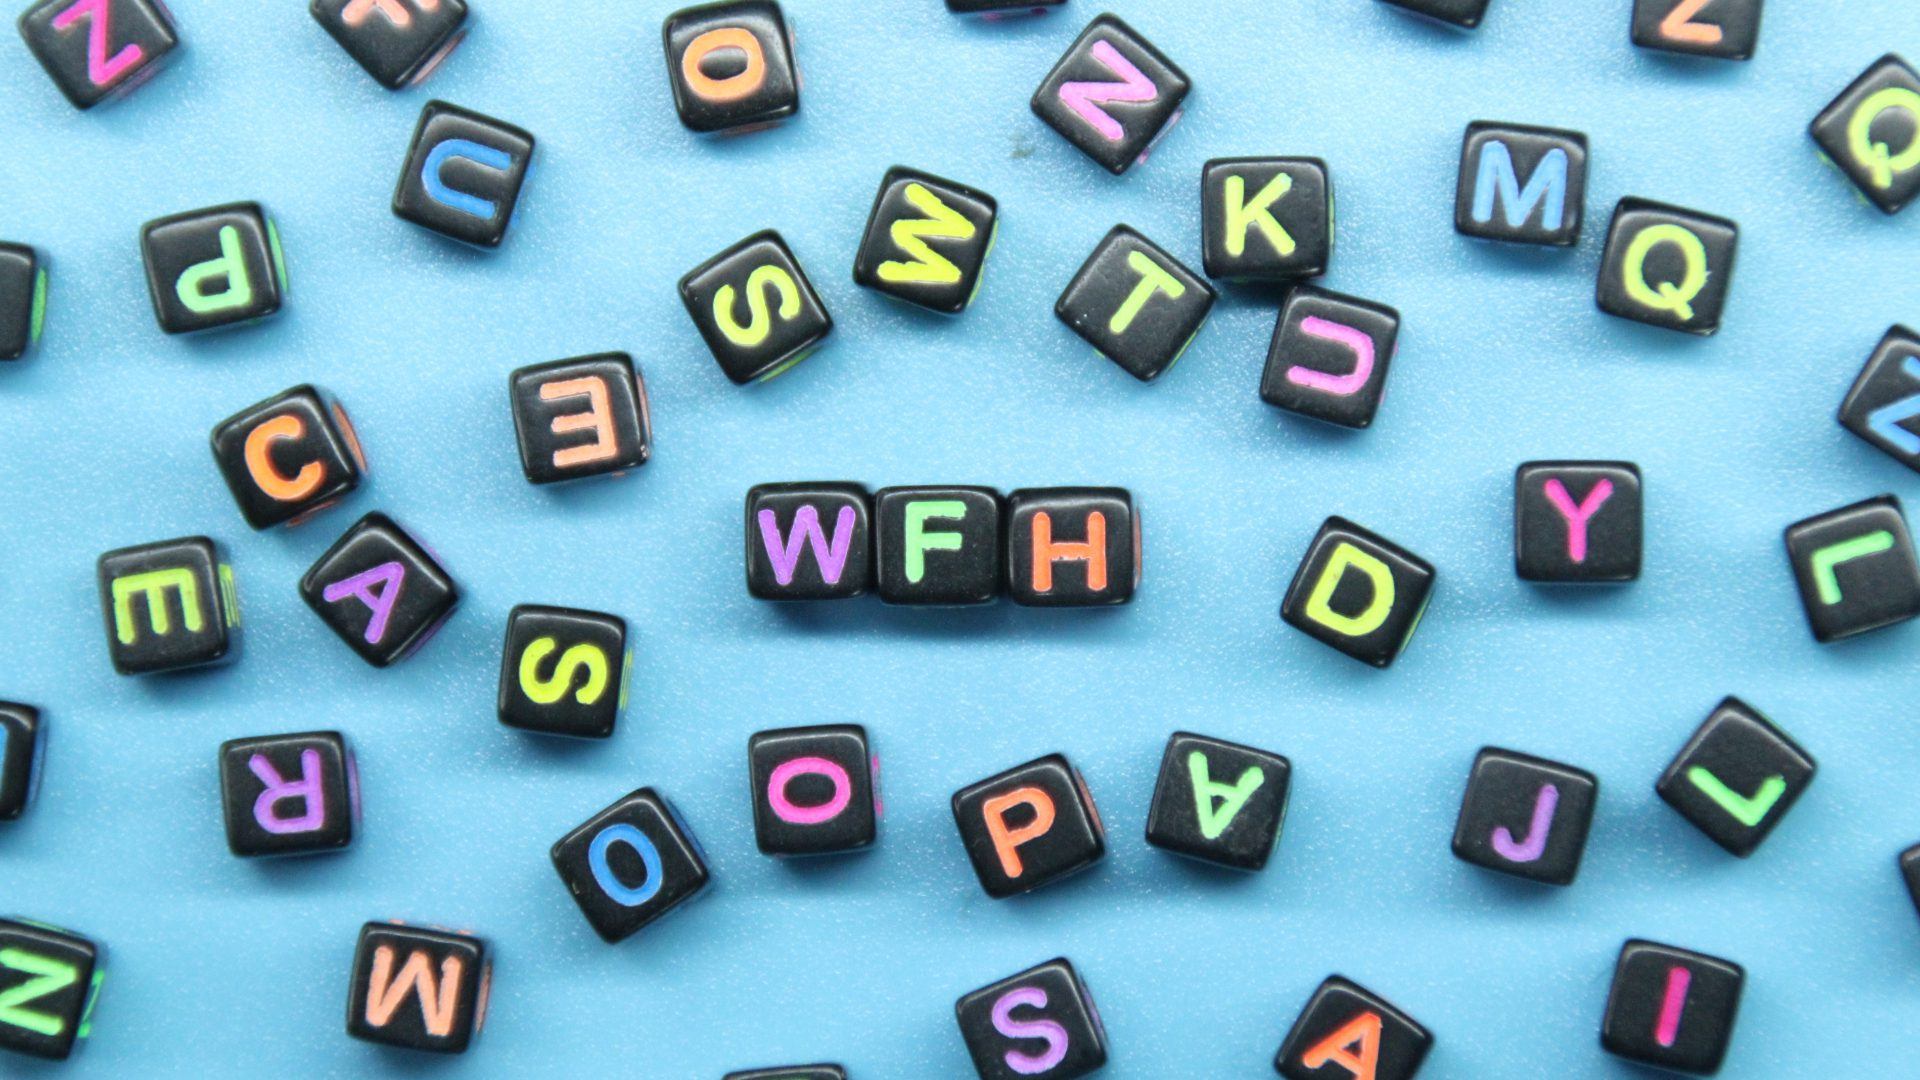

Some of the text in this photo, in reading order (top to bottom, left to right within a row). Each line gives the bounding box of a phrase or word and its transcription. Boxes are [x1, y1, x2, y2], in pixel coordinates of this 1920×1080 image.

[52, 0, 143, 86] Z
[681, 26, 766, 104] O
[1058, 39, 1158, 141] N
[420, 137, 514, 220] U
[1847, 86, 1920, 190] Q
[1224, 173, 1297, 257] K
[1470, 139, 1571, 232] M
[175, 224, 252, 314] P
[876, 181, 977, 285] W
[1622, 223, 1712, 321] Q
[712, 264, 804, 346] S
[1110, 251, 1186, 334] T
[1286, 315, 1378, 395] U
[243, 413, 328, 503] C
[540, 376, 619, 468] E
[757, 500, 1109, 594] WFH
[1543, 477, 1615, 565] Y
[111, 567, 204, 645] E
[322, 560, 406, 645] A
[1303, 543, 1397, 637] D
[1810, 529, 1896, 606] L
[518, 635, 609, 706] S
[247, 748, 326, 835] R
[767, 756, 852, 825] O
[982, 785, 1057, 880] P
[1188, 750, 1266, 840] A
[1491, 783, 1561, 863] J
[1686, 764, 1787, 828] L
[587, 822, 664, 908] O
[991, 985, 1070, 1076] S
[1301, 1010, 1384, 1080] A
[1655, 965, 1693, 1048] I
